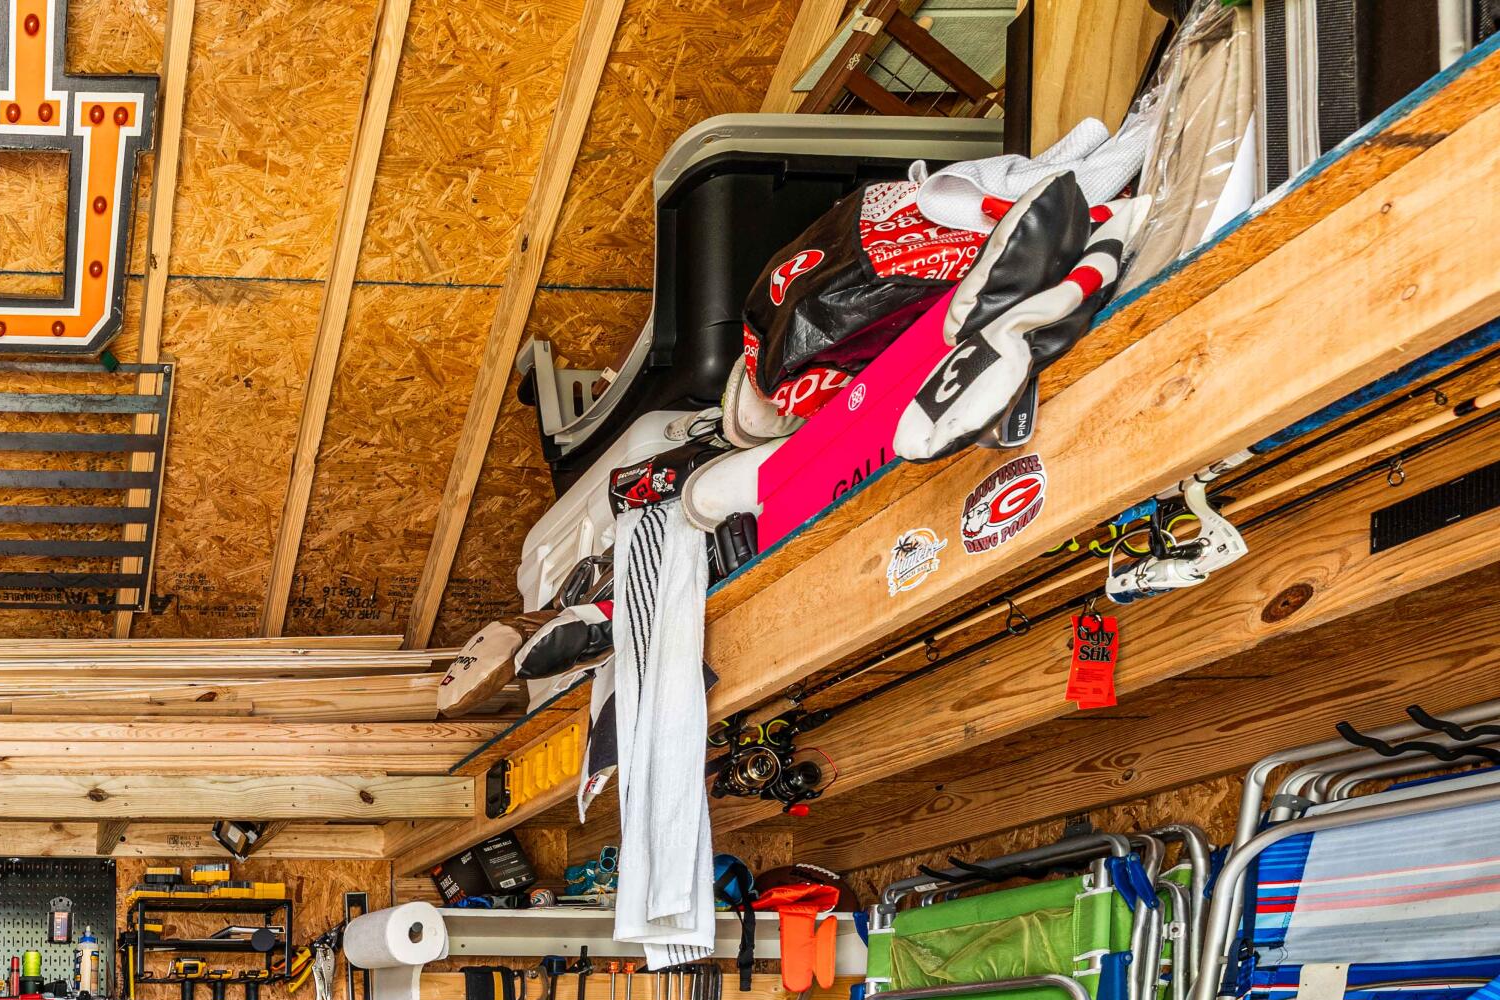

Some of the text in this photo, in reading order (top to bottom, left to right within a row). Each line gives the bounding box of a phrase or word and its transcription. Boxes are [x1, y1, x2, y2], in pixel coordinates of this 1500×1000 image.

[913, 248, 949, 268] not
[955, 246, 980, 264] yo
[1018, 413, 1027, 437] PING
[963, 455, 1043, 518] DAUFUSKIE
[963, 497, 1044, 553] DAWG POUND
[358, 610, 380, 620] MAR
[1077, 627, 1115, 646] Ugly
[1078, 645, 1112, 662] Stik
[440, 874, 454, 890] TABLE
[445, 882, 460, 899] TENNIS
